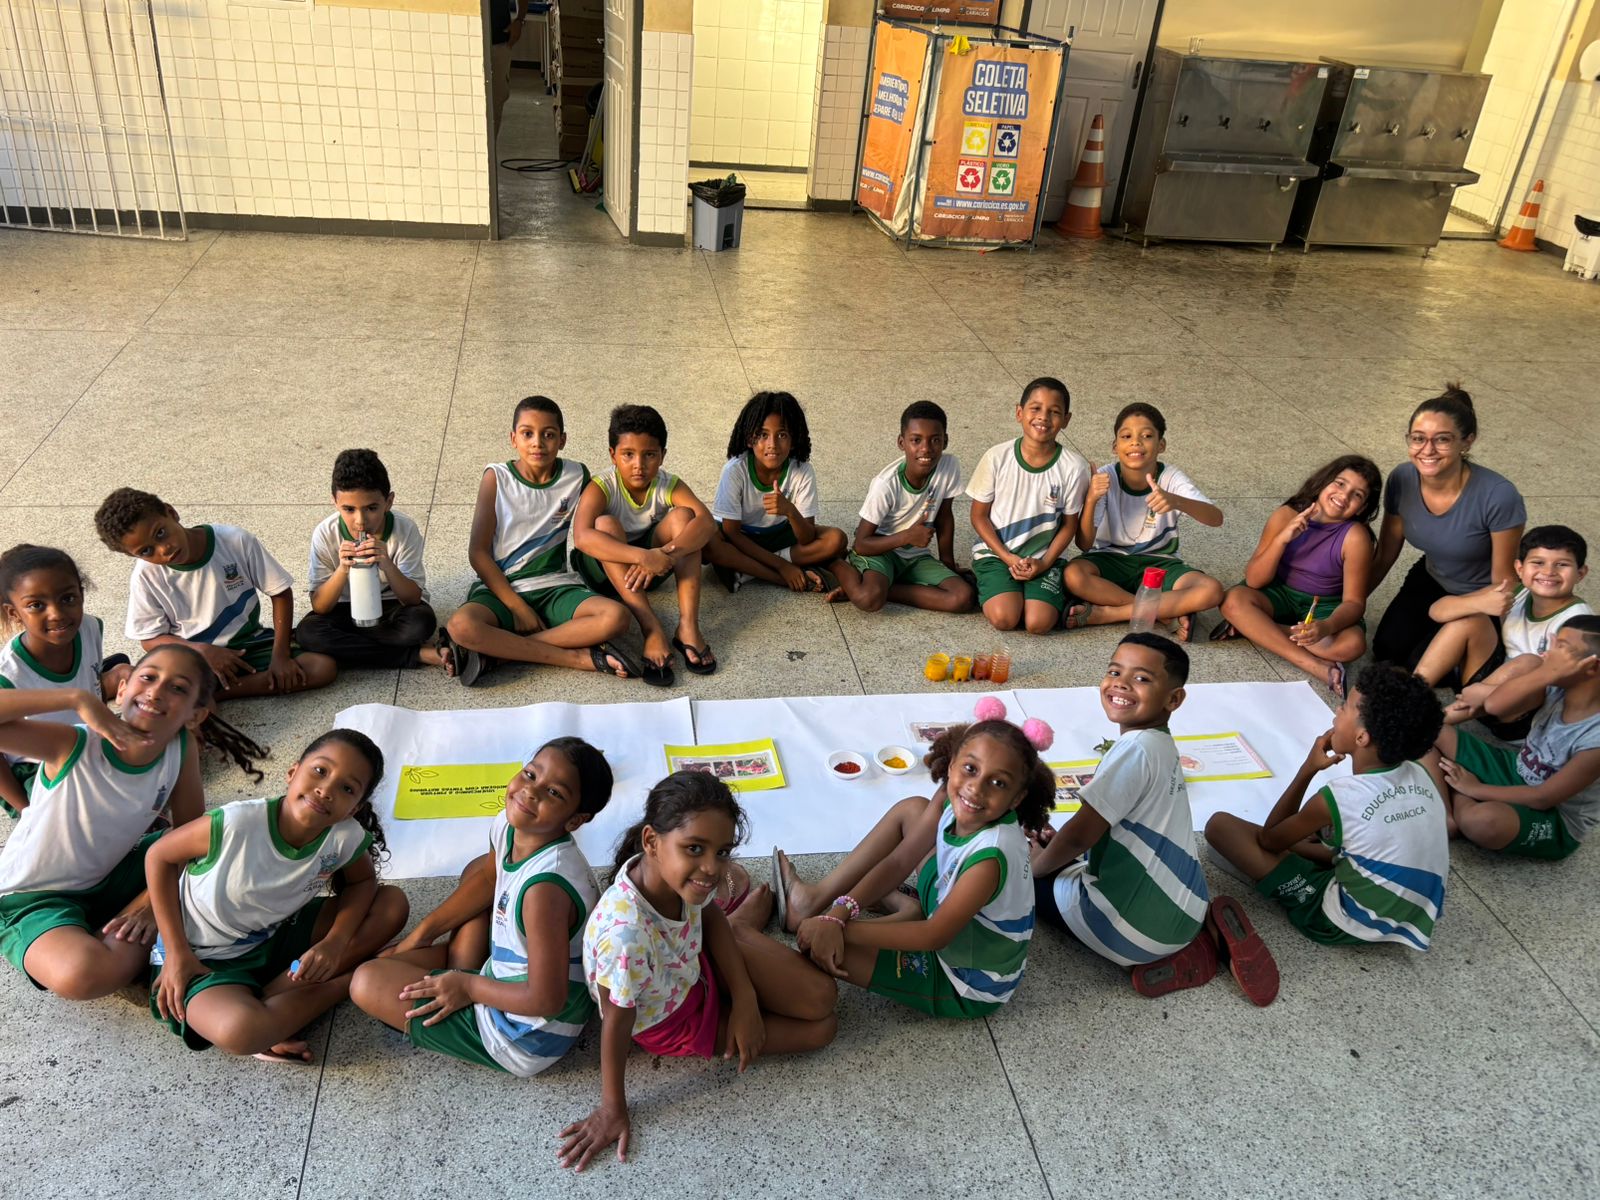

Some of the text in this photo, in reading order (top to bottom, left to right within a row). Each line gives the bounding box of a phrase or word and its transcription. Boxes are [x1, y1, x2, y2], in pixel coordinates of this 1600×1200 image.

[974, 63, 1025, 89] COLETA
[964, 90, 1026, 116] SELETIVA
[1384, 806, 1427, 824] CARIACICA
